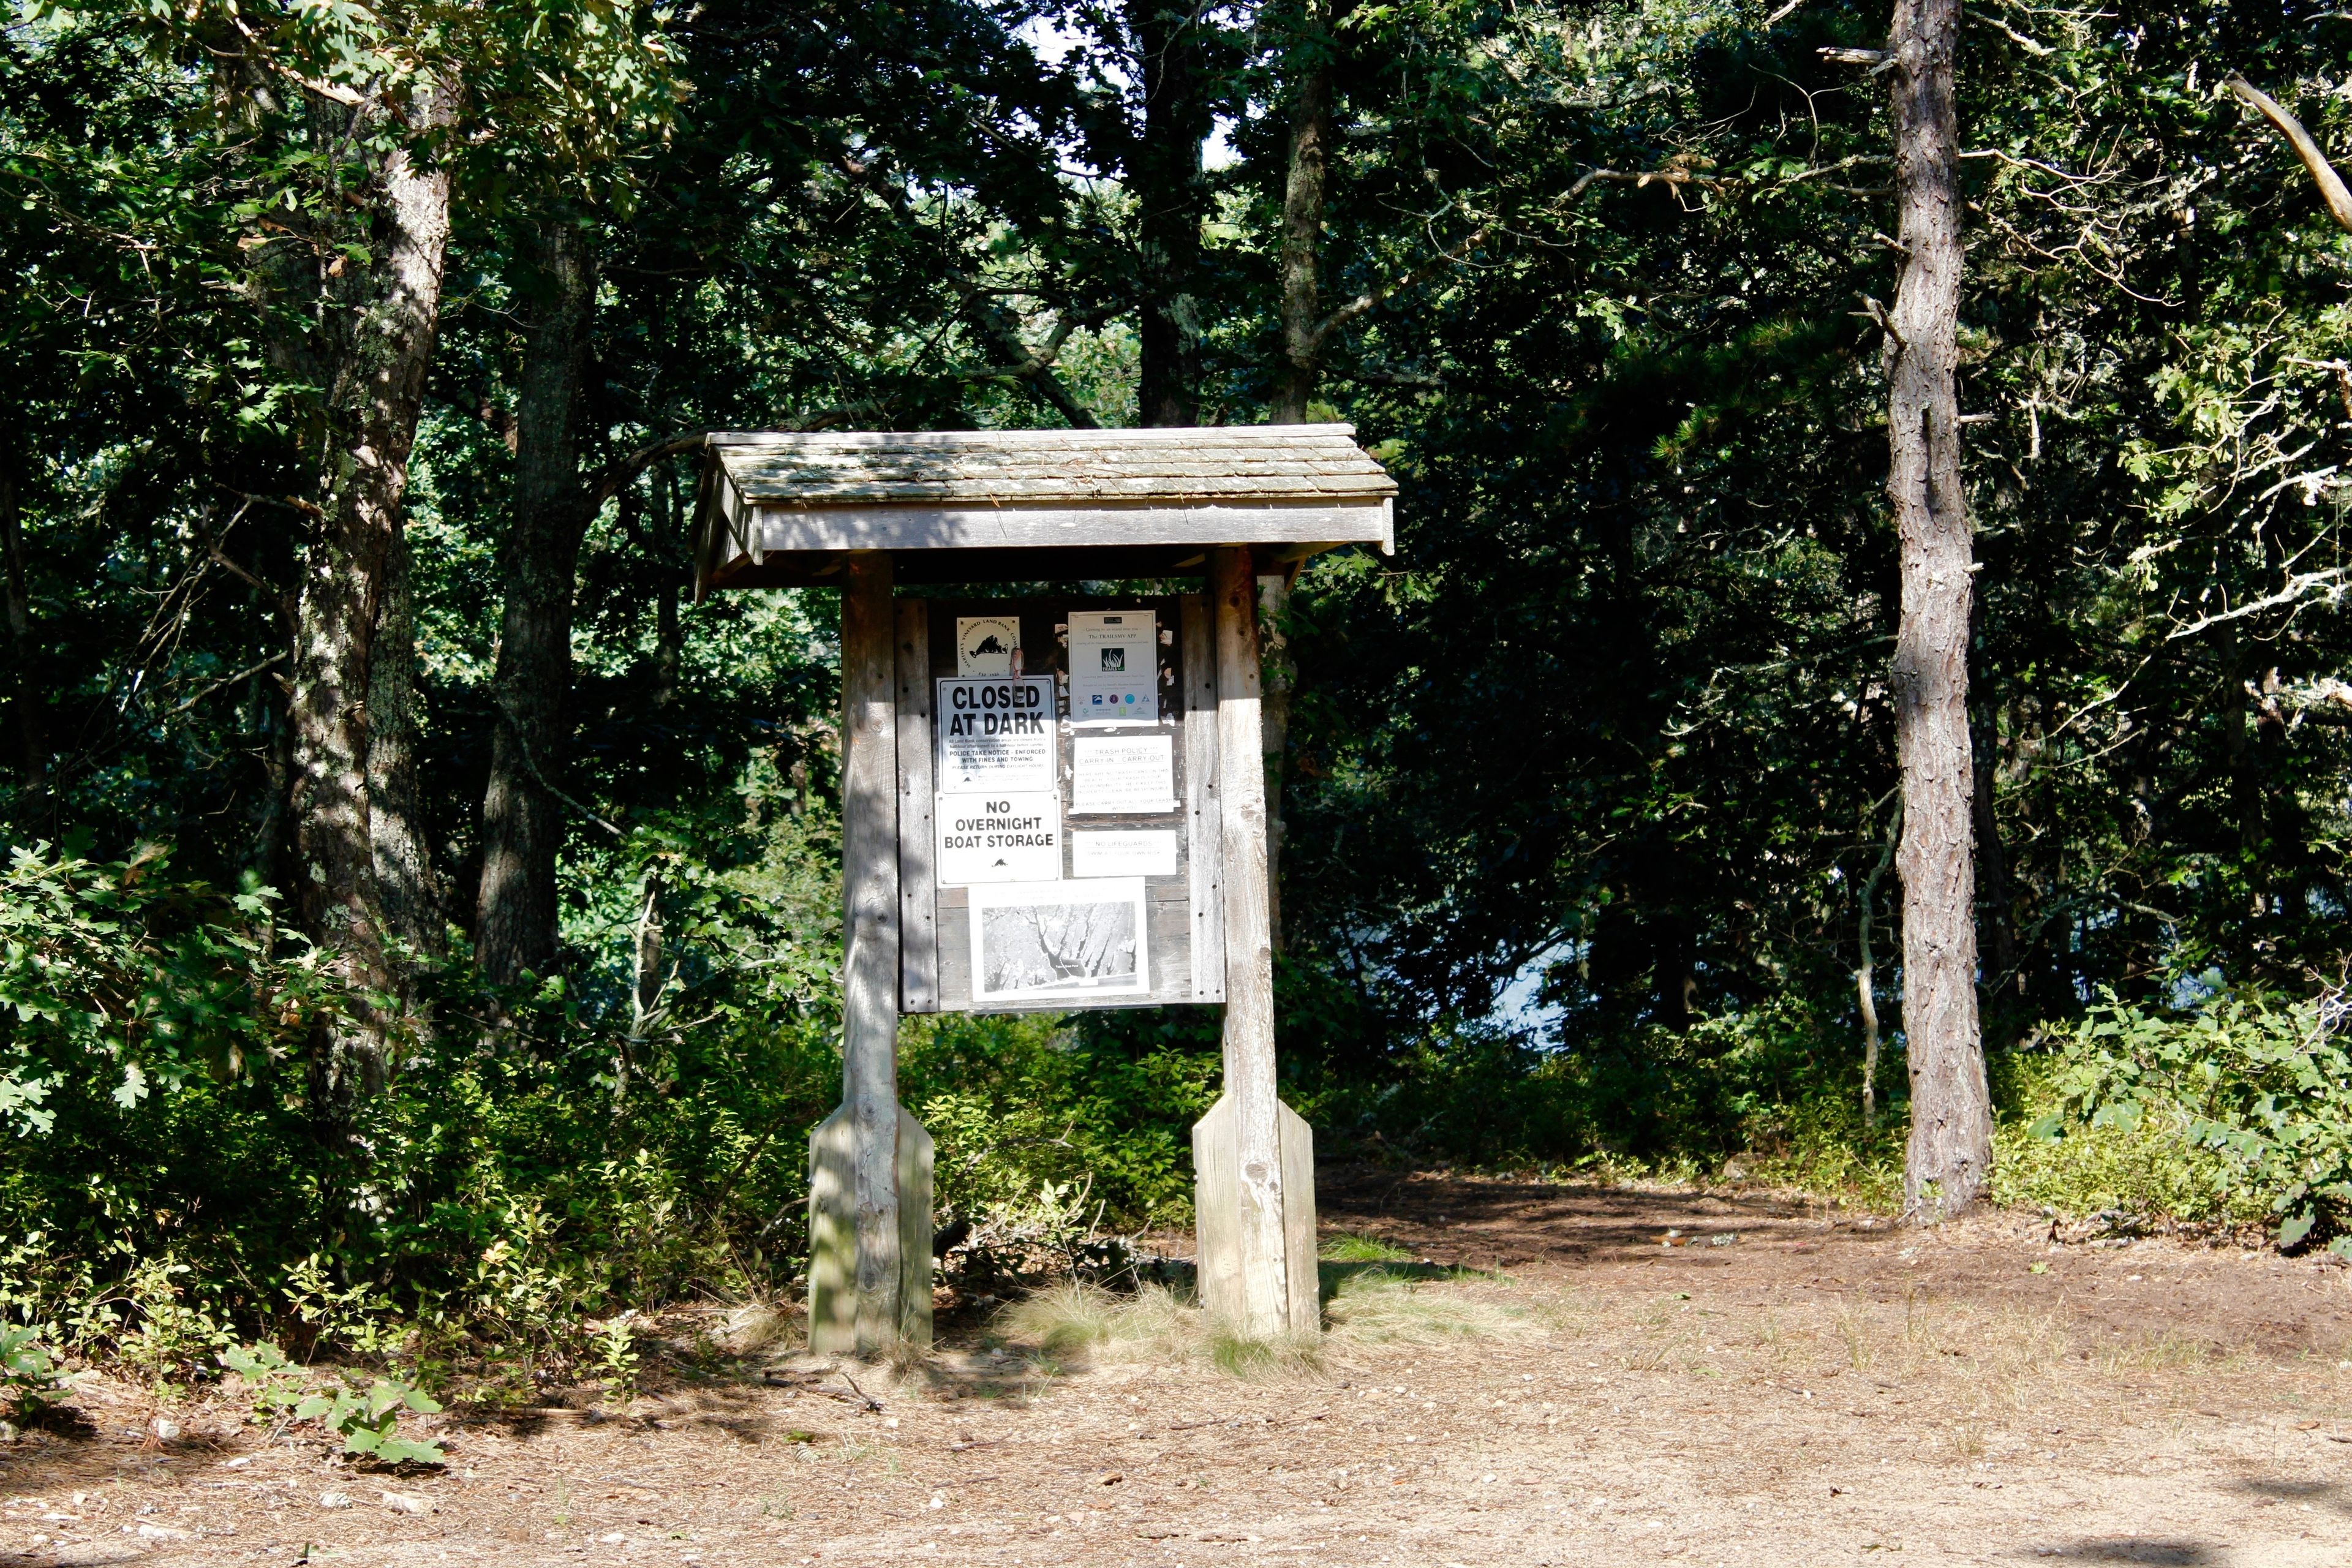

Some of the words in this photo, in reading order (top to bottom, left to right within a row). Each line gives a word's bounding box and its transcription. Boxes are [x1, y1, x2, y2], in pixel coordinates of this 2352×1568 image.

[962, 621, 981, 640] VINEYARD
[998, 621, 1011, 631] BANK
[960, 643, 970, 668] MARTHA'S
[952, 685, 1039, 709] CLOSED
[950, 714, 976, 736] AT
[984, 712, 1044, 736] DARK
[986, 801, 1011, 813] NO
[956, 817, 1042, 832] OVERNIGHT
[945, 836, 982, 849] BOAT
[987, 834, 1054, 848] STORAGE
